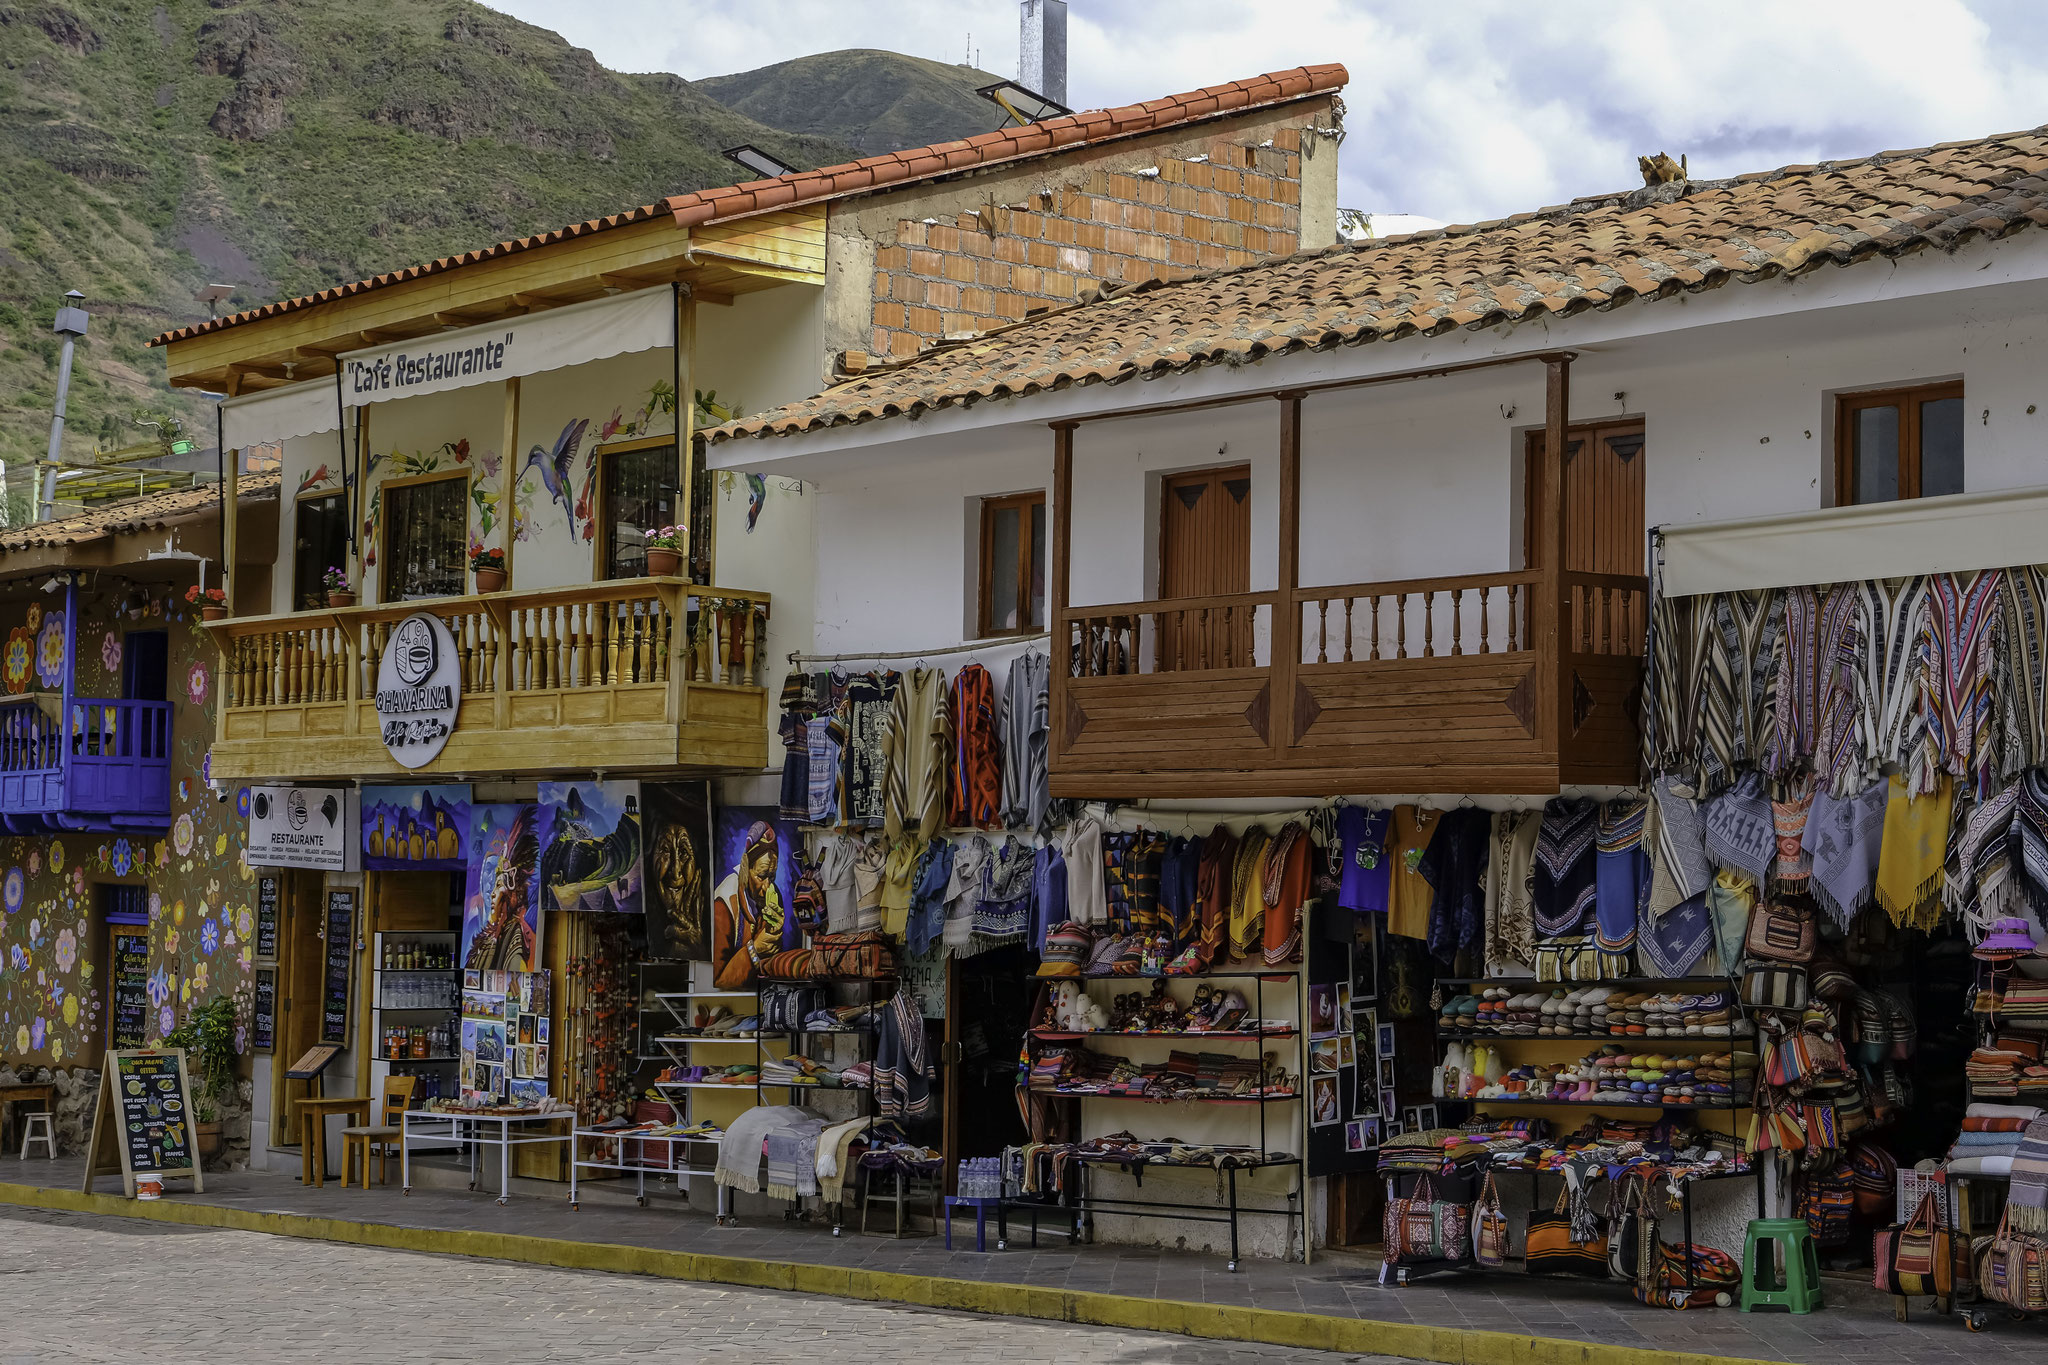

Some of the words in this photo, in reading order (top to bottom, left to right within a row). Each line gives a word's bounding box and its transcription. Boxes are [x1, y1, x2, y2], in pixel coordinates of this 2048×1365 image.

[348, 353, 390, 394] "Café
[394, 332, 514, 387] Restaurante"
[376, 686, 450, 712] QHAWARINA
[270, 833, 324, 846] RESTAURANTE
